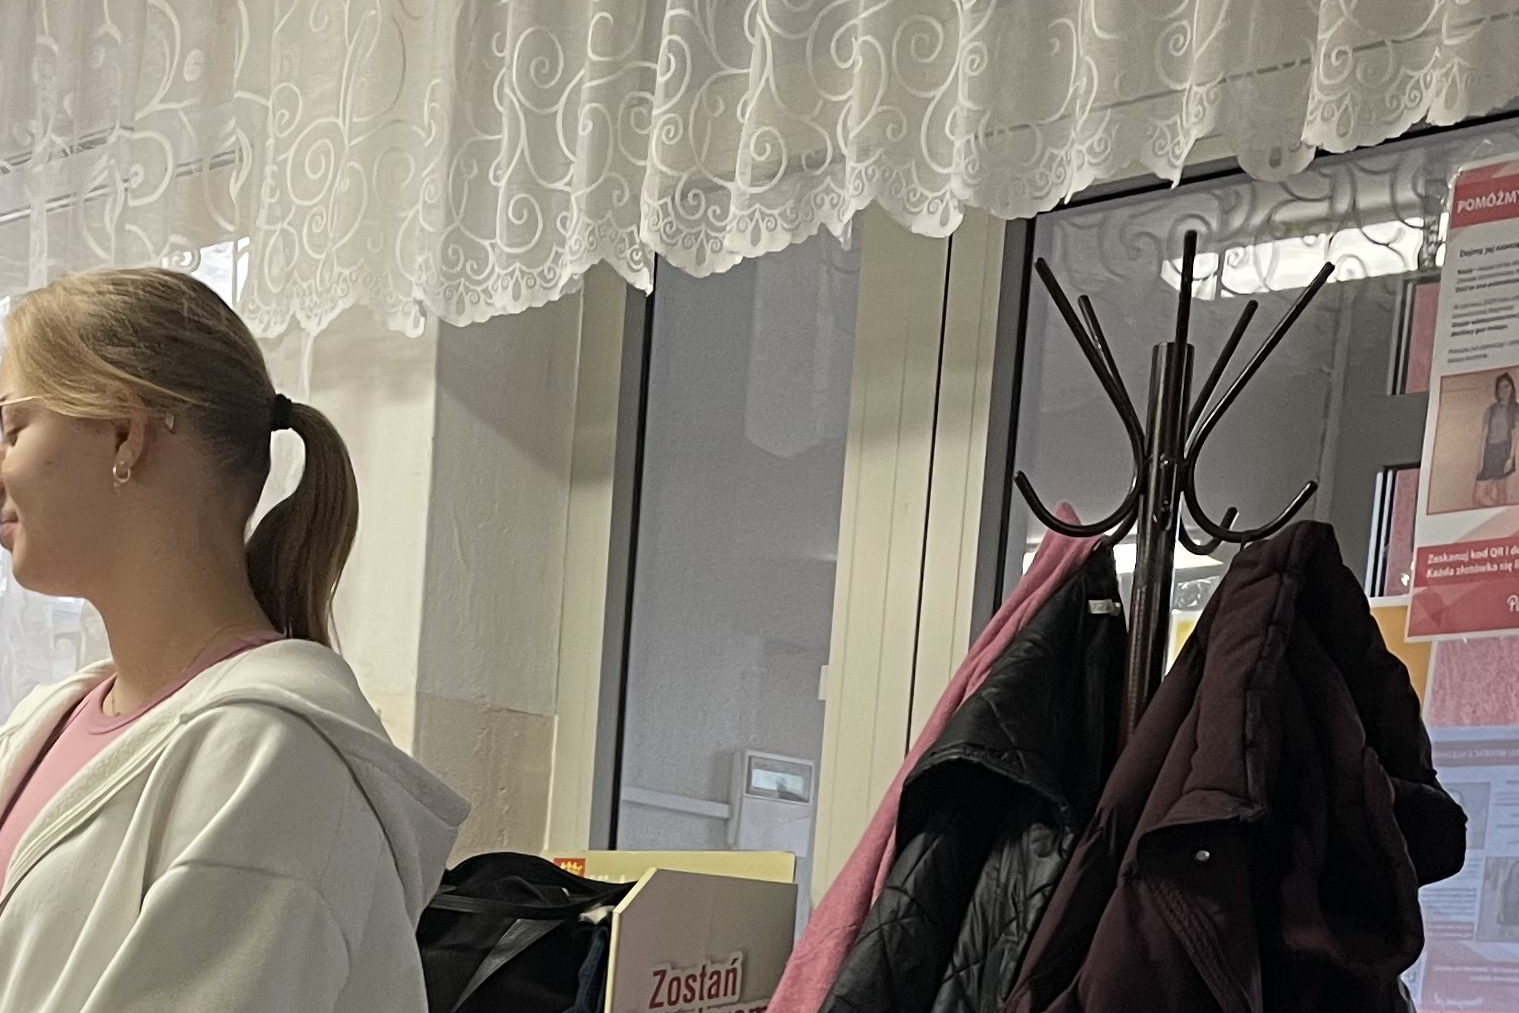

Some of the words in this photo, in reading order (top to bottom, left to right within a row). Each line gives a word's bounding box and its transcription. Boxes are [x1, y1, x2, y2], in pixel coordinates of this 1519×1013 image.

[1470, 547, 1488, 559] kod
[1490, 546, 1503, 558] QR
[1426, 566, 1454, 578] Każda
[649, 957, 739, 1010] Zostań
